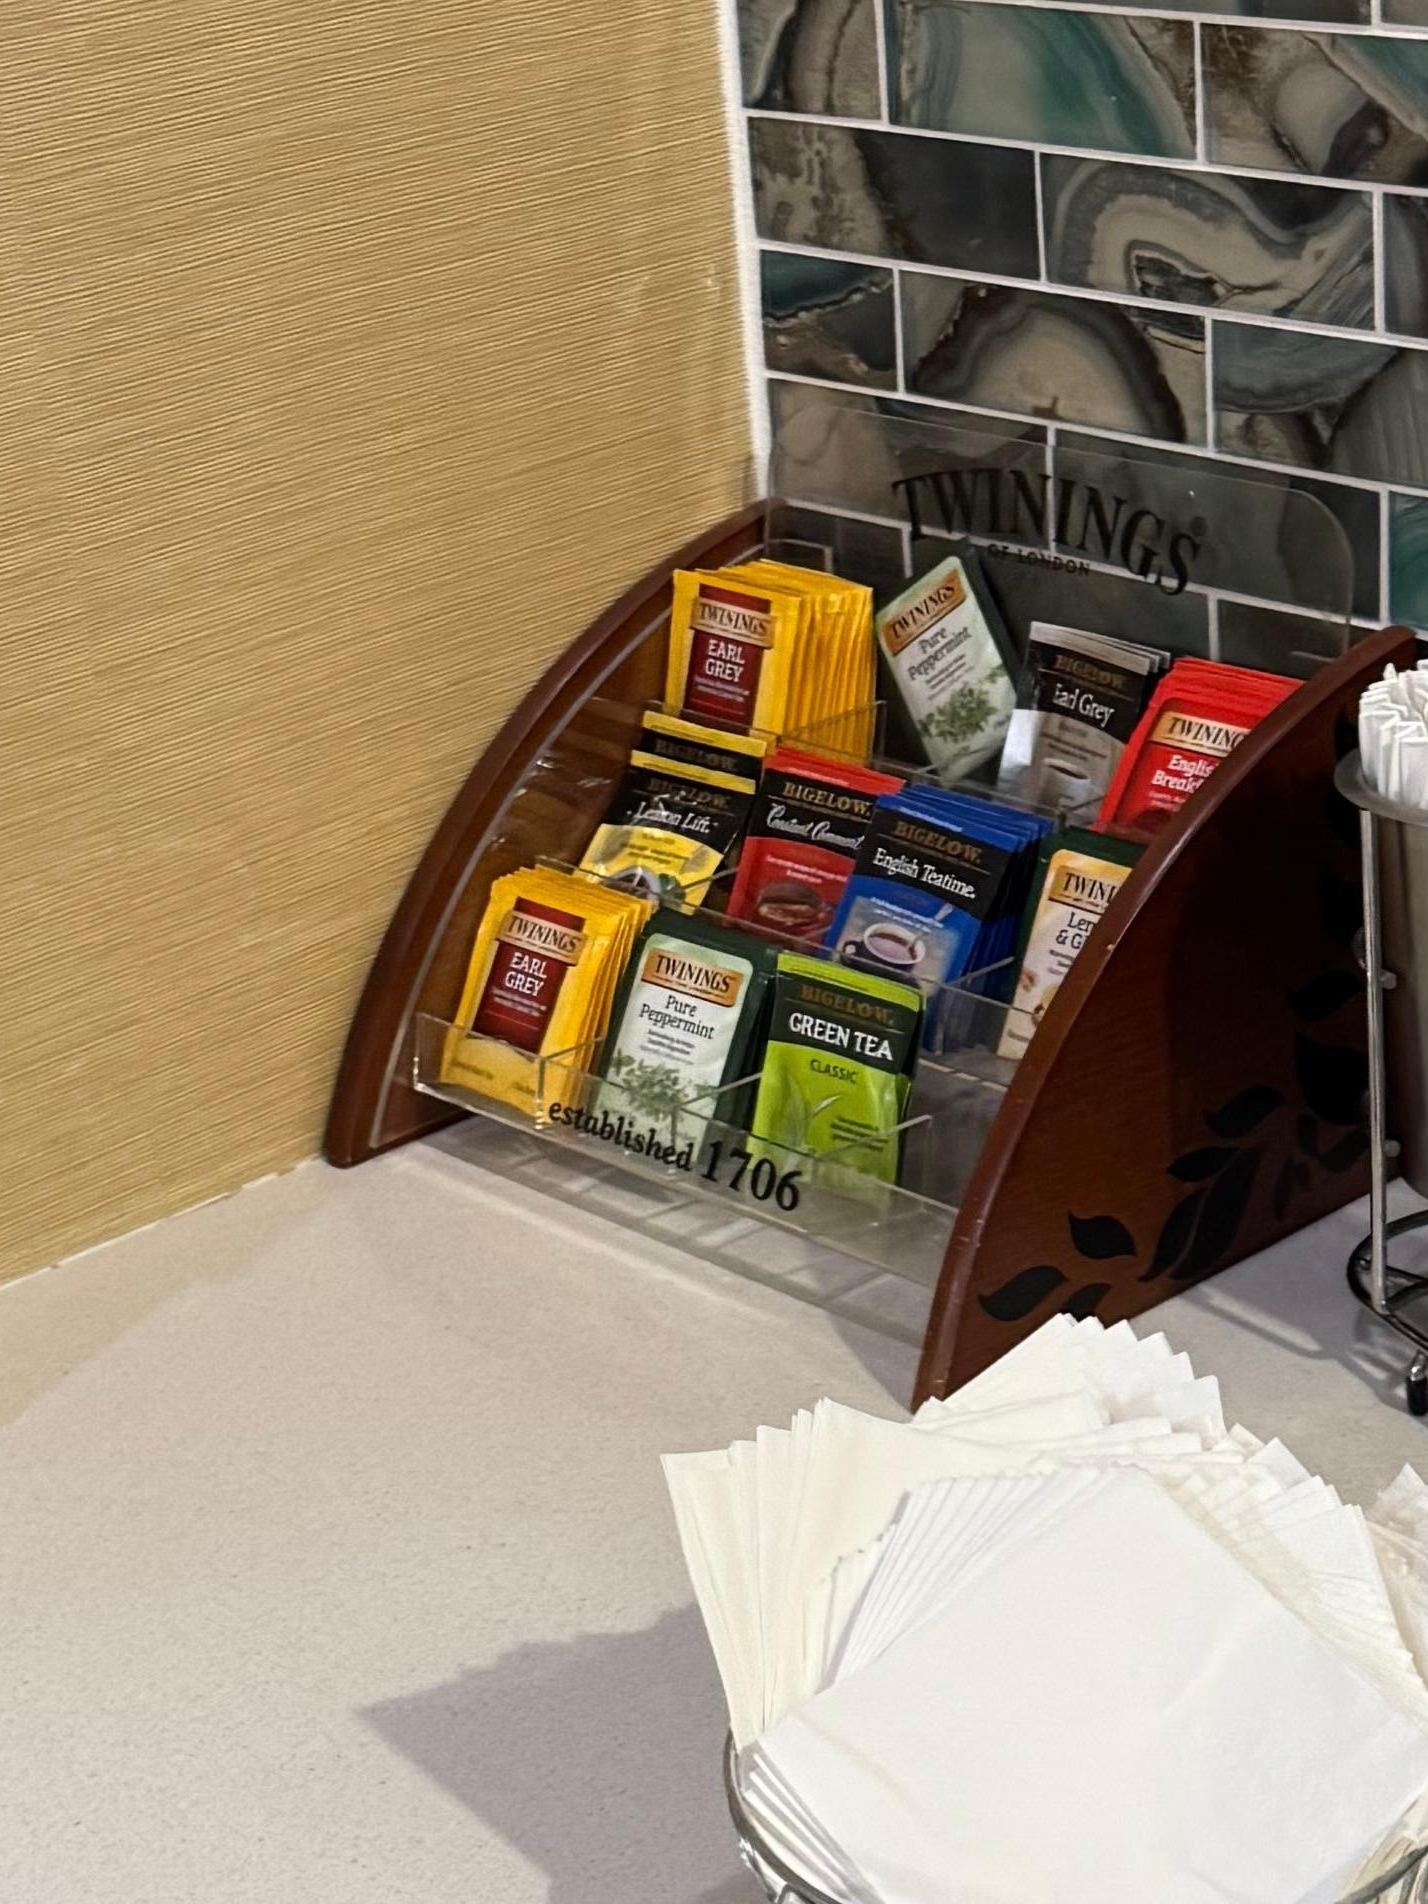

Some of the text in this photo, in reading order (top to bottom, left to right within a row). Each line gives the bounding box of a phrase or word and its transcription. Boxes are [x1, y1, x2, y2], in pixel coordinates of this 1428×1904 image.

[891, 467, 1203, 596] TWININGS
[699, 602, 767, 635] TWININGS
[892, 585, 955, 638] TWININGS
[708, 639, 745, 664] EARL
[907, 626, 973, 680] Peppermint
[919, 627, 948, 653] Pure
[705, 659, 744, 682] GREY
[1079, 693, 1115, 727] Grey
[1167, 716, 1247, 747] TWININ
[1168, 754, 1219, 778] Englis
[783, 781, 870, 816] BIGELOW
[893, 821, 982, 862] BIGELOW
[873, 847, 919, 878] English
[922, 864, 976, 899] Teatime
[508, 917, 582, 951] TWININGS
[510, 952, 547, 979] EARL
[655, 955, 731, 993] TWININGS
[505, 971, 544, 996] GREY
[639, 1003, 715, 1040] Peppermint
[665, 994, 698, 1017] Pure
[789, 1012, 893, 1061] GREEN TEA
[809, 1059, 858, 1084] CLASSIC
[548, 1101, 802, 1211] established 1706
